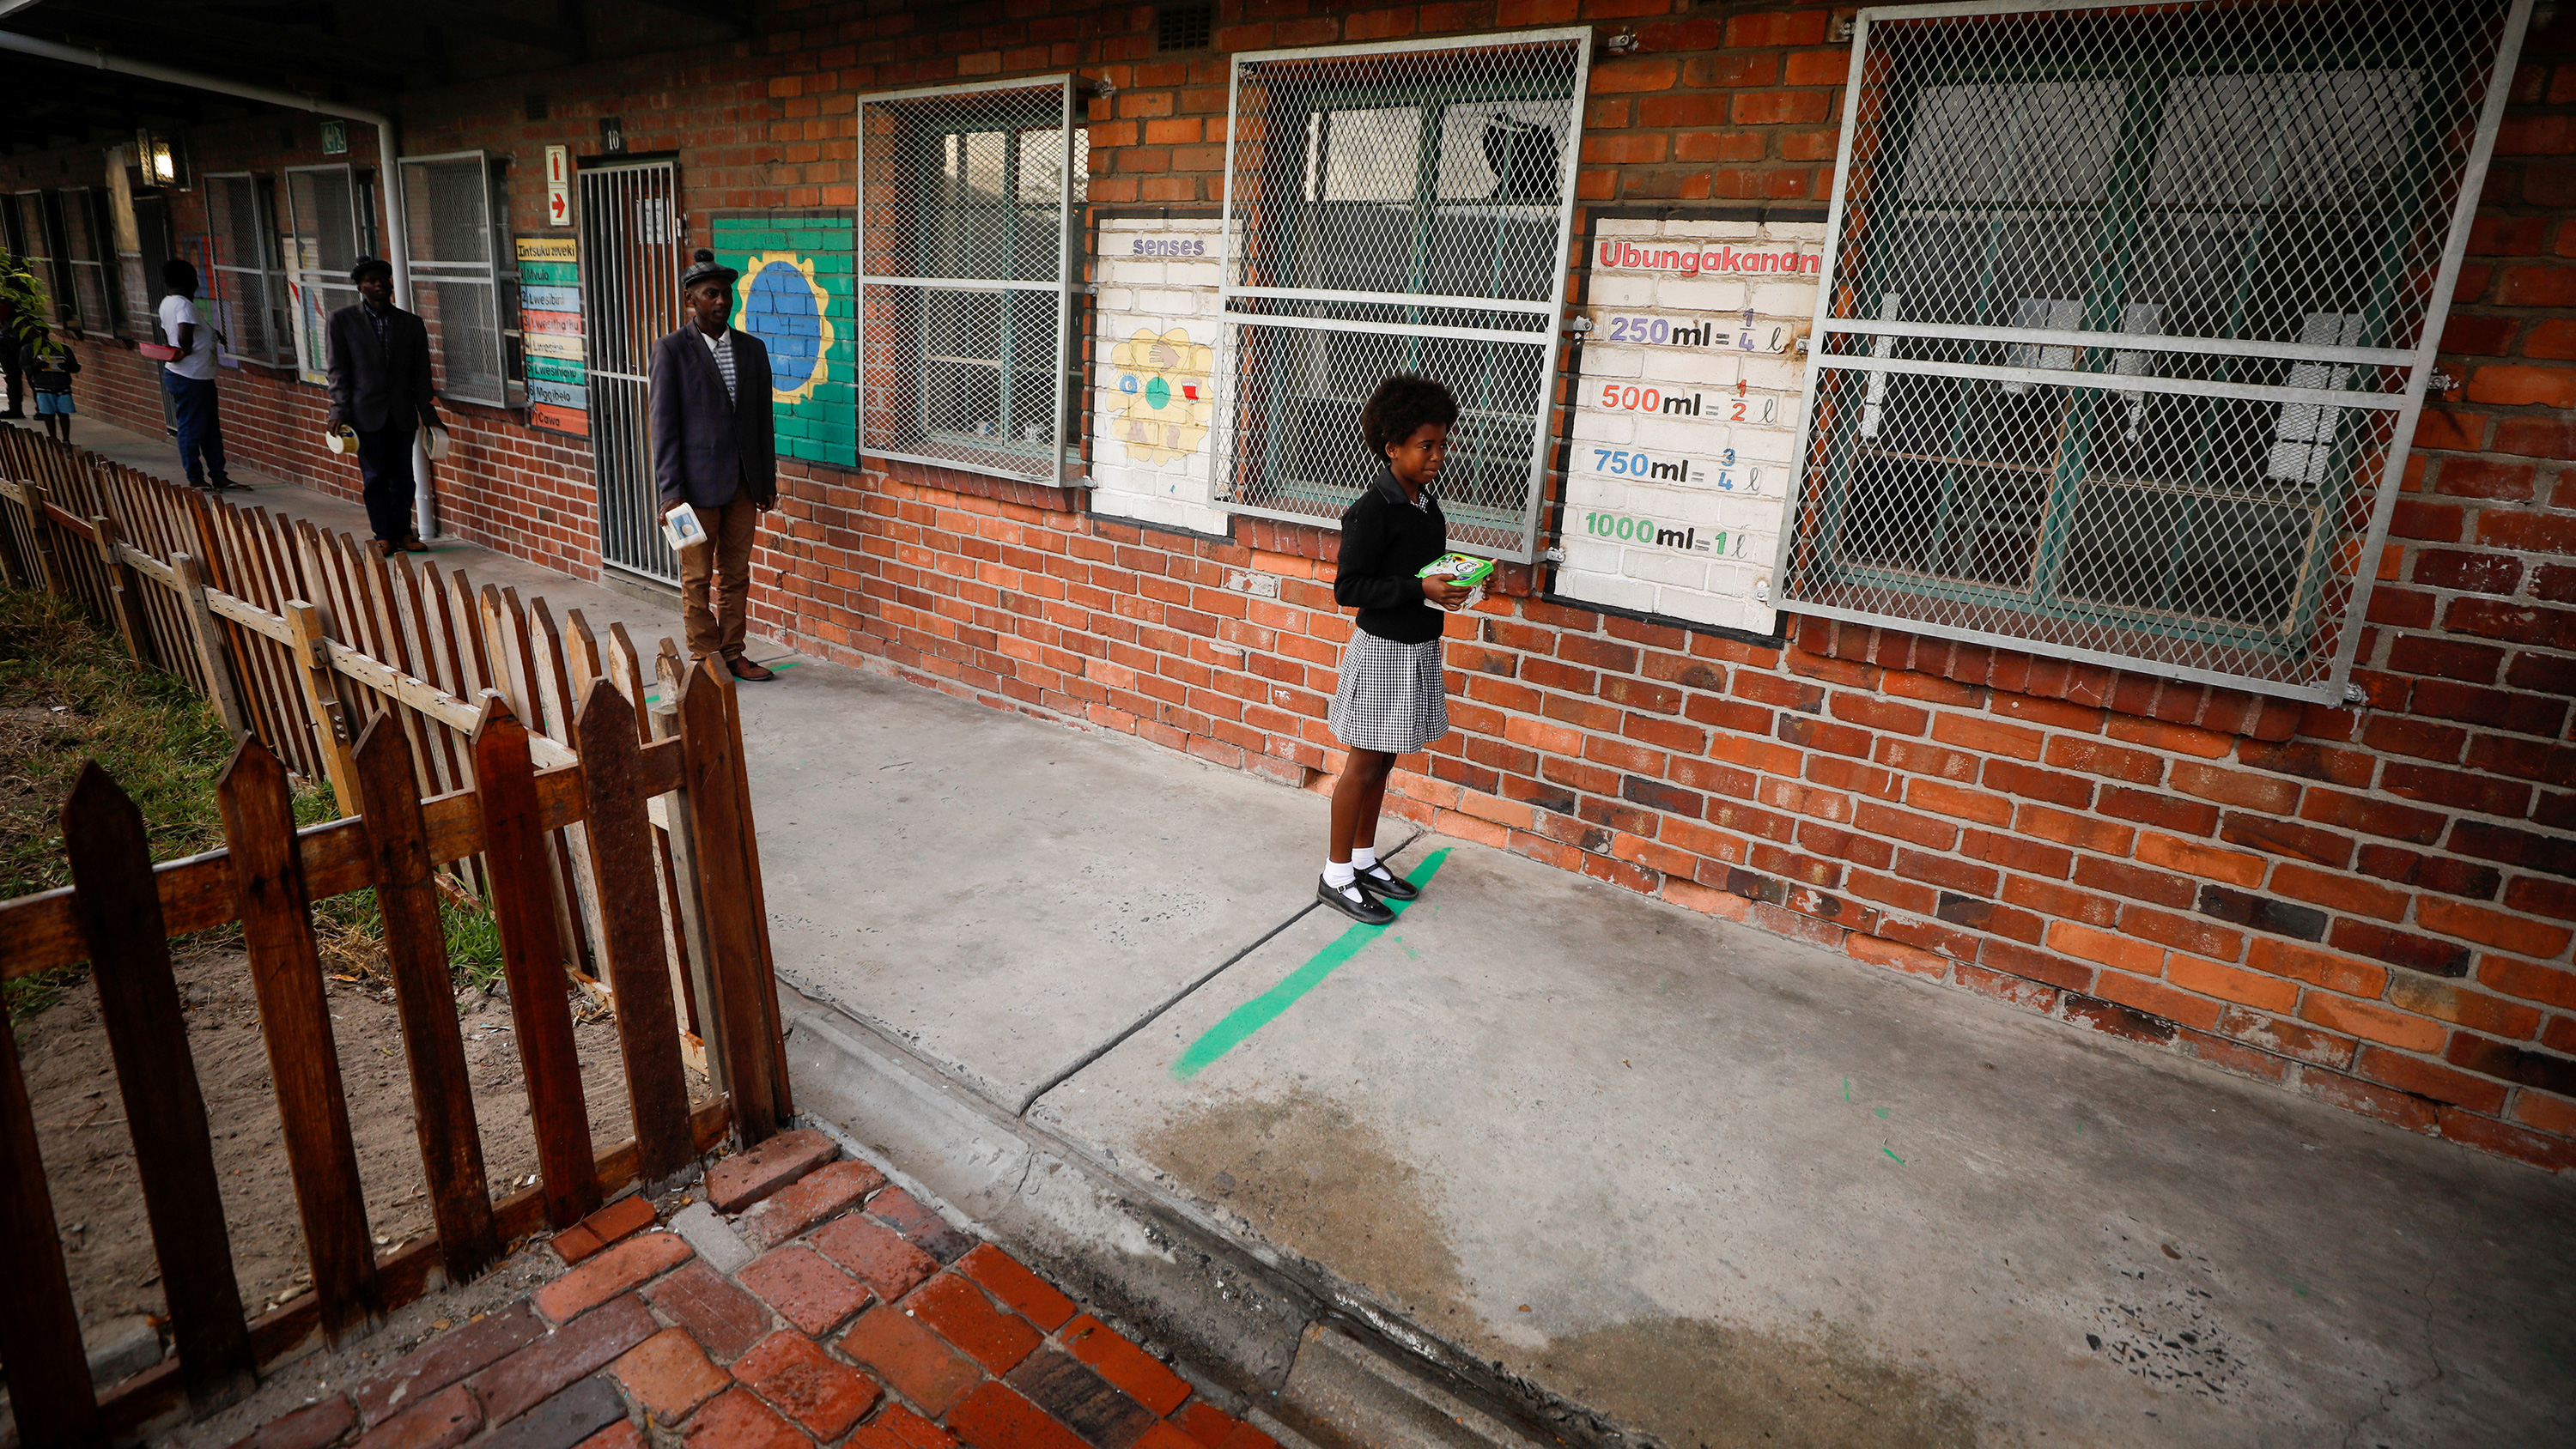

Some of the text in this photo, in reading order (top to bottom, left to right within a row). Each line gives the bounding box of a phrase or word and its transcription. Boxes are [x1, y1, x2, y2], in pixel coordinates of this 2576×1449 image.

[607, 130, 620, 150] 10
[1133, 239, 1205, 256] senses
[1600, 242, 1823, 278] Ubungakanan
[536, 386, 571, 403] Mgqibelo
[538, 411, 561, 427] Cawa
